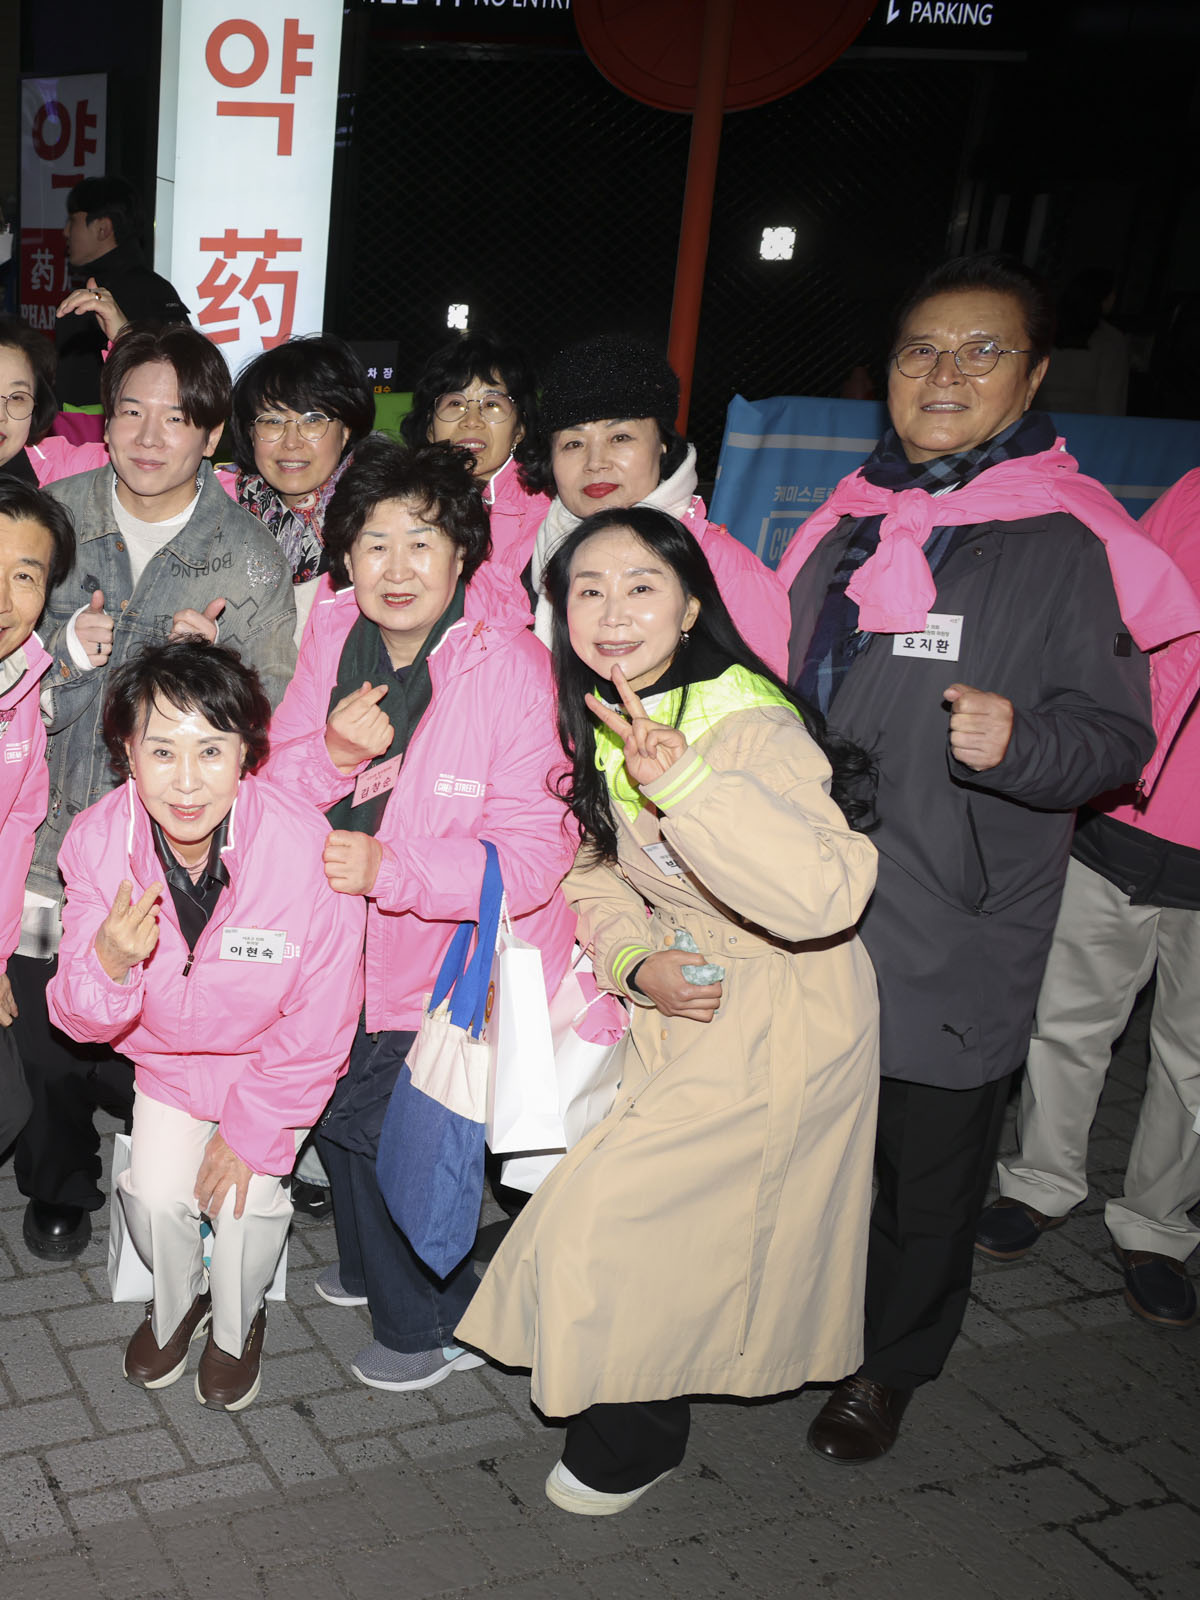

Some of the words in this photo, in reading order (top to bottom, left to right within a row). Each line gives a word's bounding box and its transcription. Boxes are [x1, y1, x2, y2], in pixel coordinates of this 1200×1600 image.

[910, 1, 993, 26] PARKING
[204, 18, 314, 157] 약
[195, 228, 303, 350] 药
[367, 367, 394, 380] 차장
[773, 485, 837, 503] 케미스트
[903, 636, 950, 654] 오지환
[454, 782, 477, 794] STREET
[229, 945, 274, 959] 이현숙
